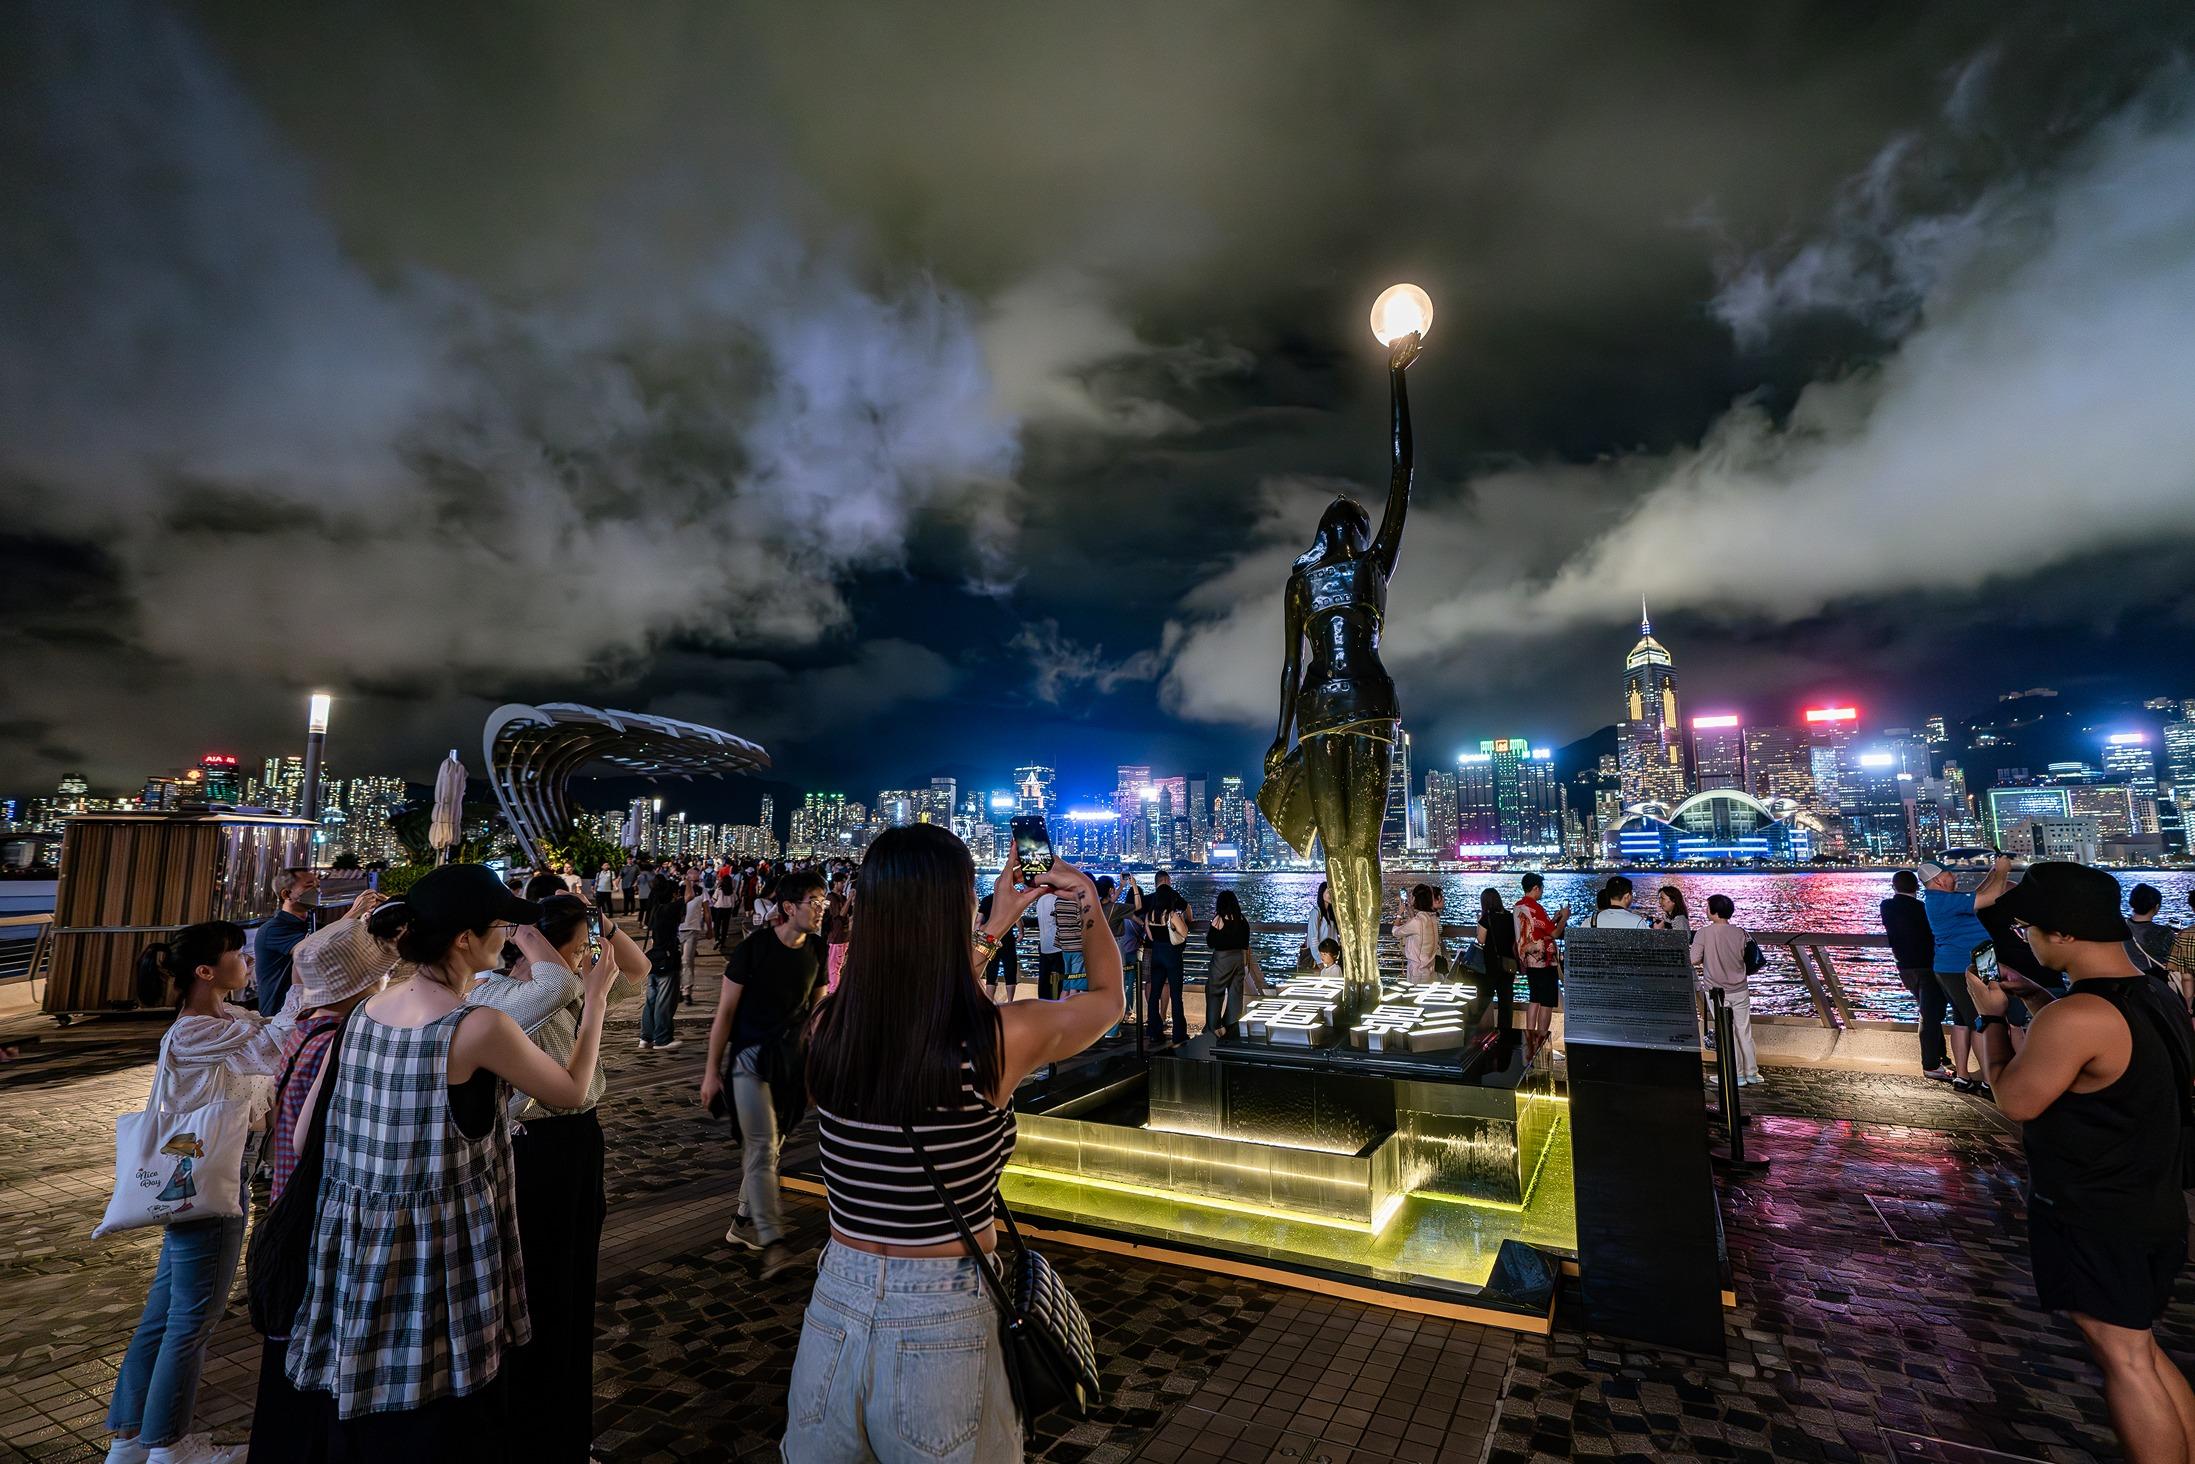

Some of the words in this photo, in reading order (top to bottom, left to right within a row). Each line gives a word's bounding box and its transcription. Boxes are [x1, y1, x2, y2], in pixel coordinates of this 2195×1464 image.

[1238, 997, 1465, 1045] 電影
[136, 1170, 159, 1180] Nice
[140, 1179, 162, 1188] Day
